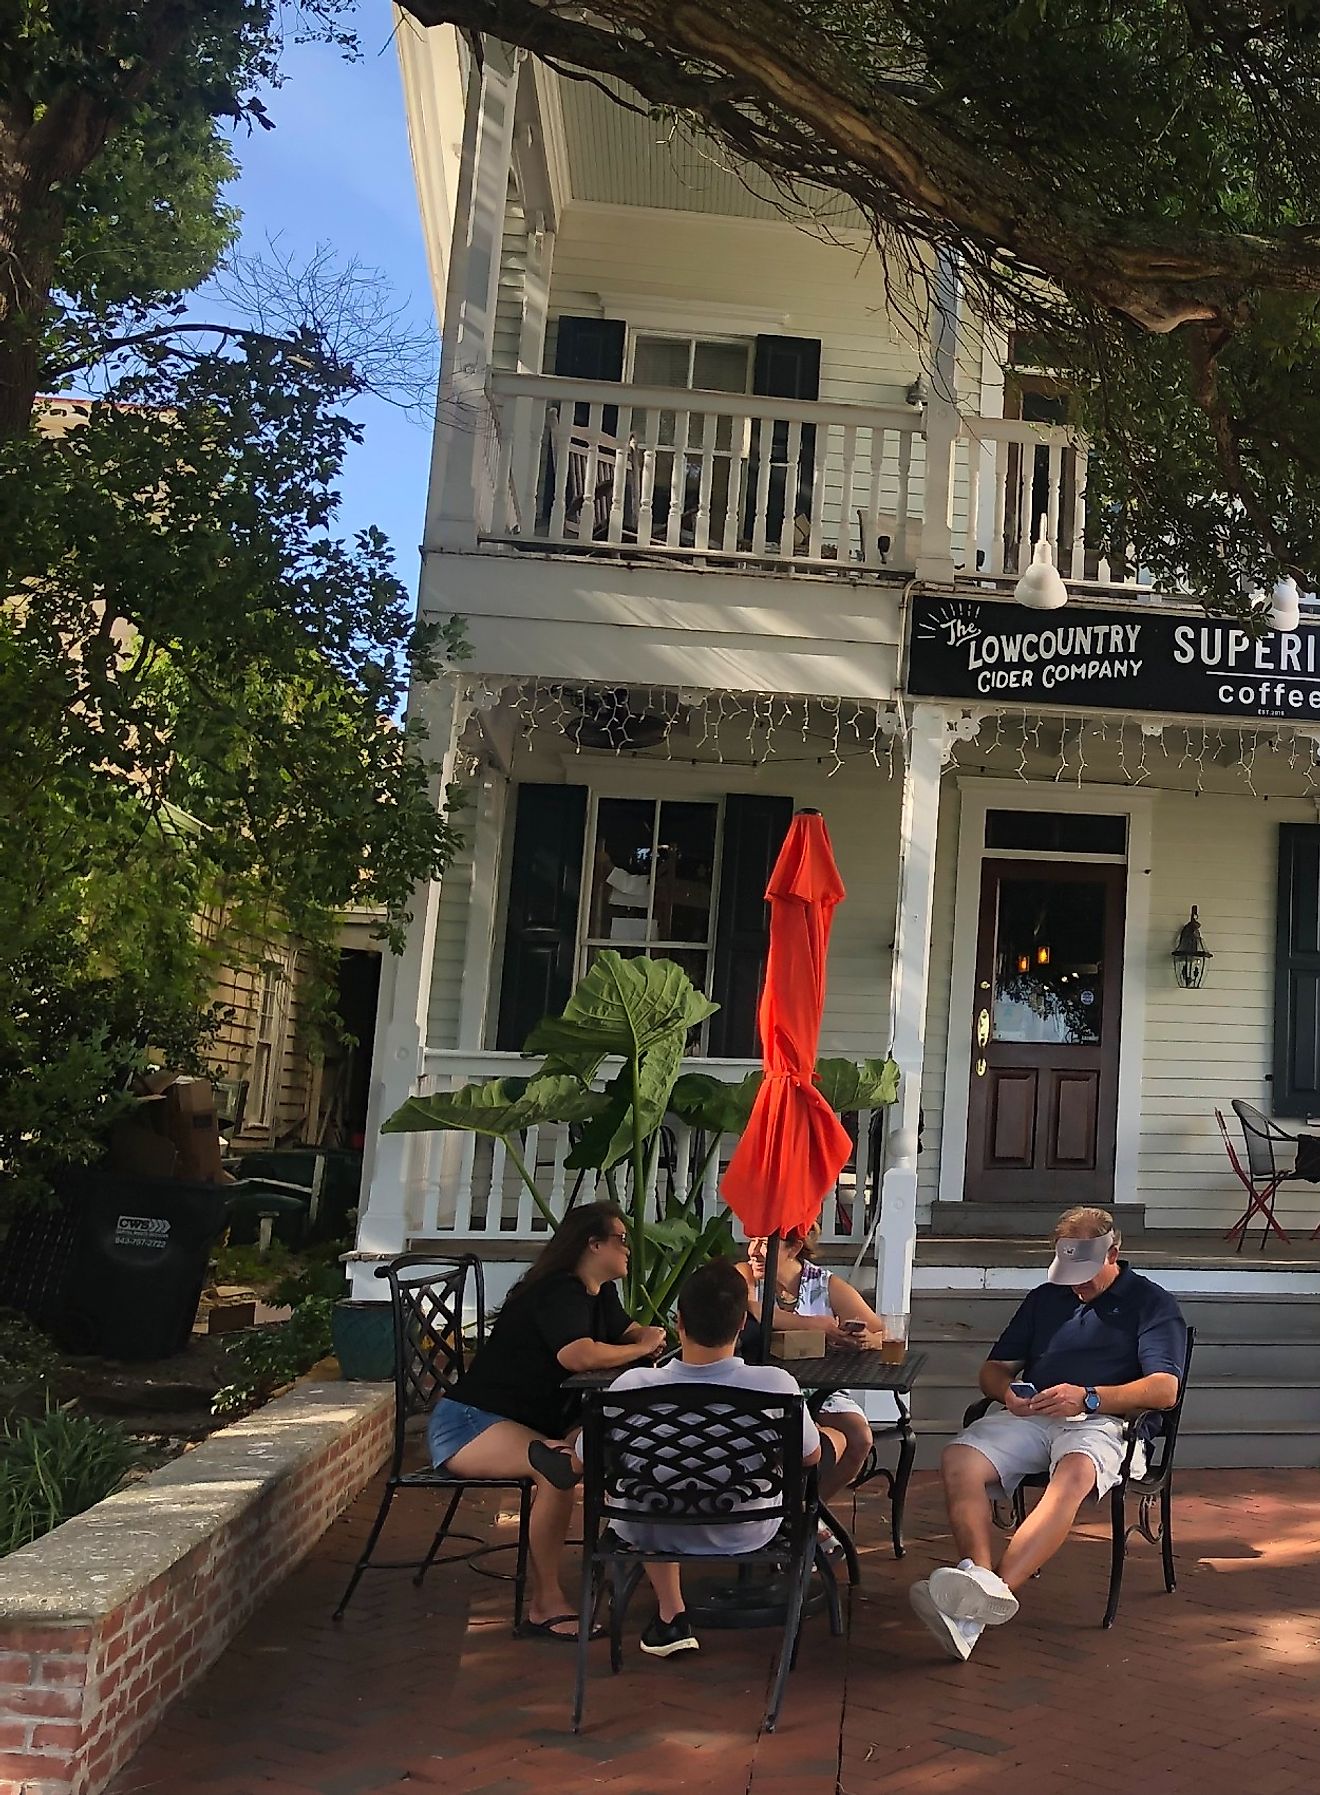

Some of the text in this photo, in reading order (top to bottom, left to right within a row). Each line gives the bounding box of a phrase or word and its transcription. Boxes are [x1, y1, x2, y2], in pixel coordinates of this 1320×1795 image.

[940, 618, 982, 646] The
[968, 624, 1142, 670] LOWCOUNTRY
[977, 659, 1143, 693] CIDER COMPANY
[119, 1219, 150, 1231] CWS
